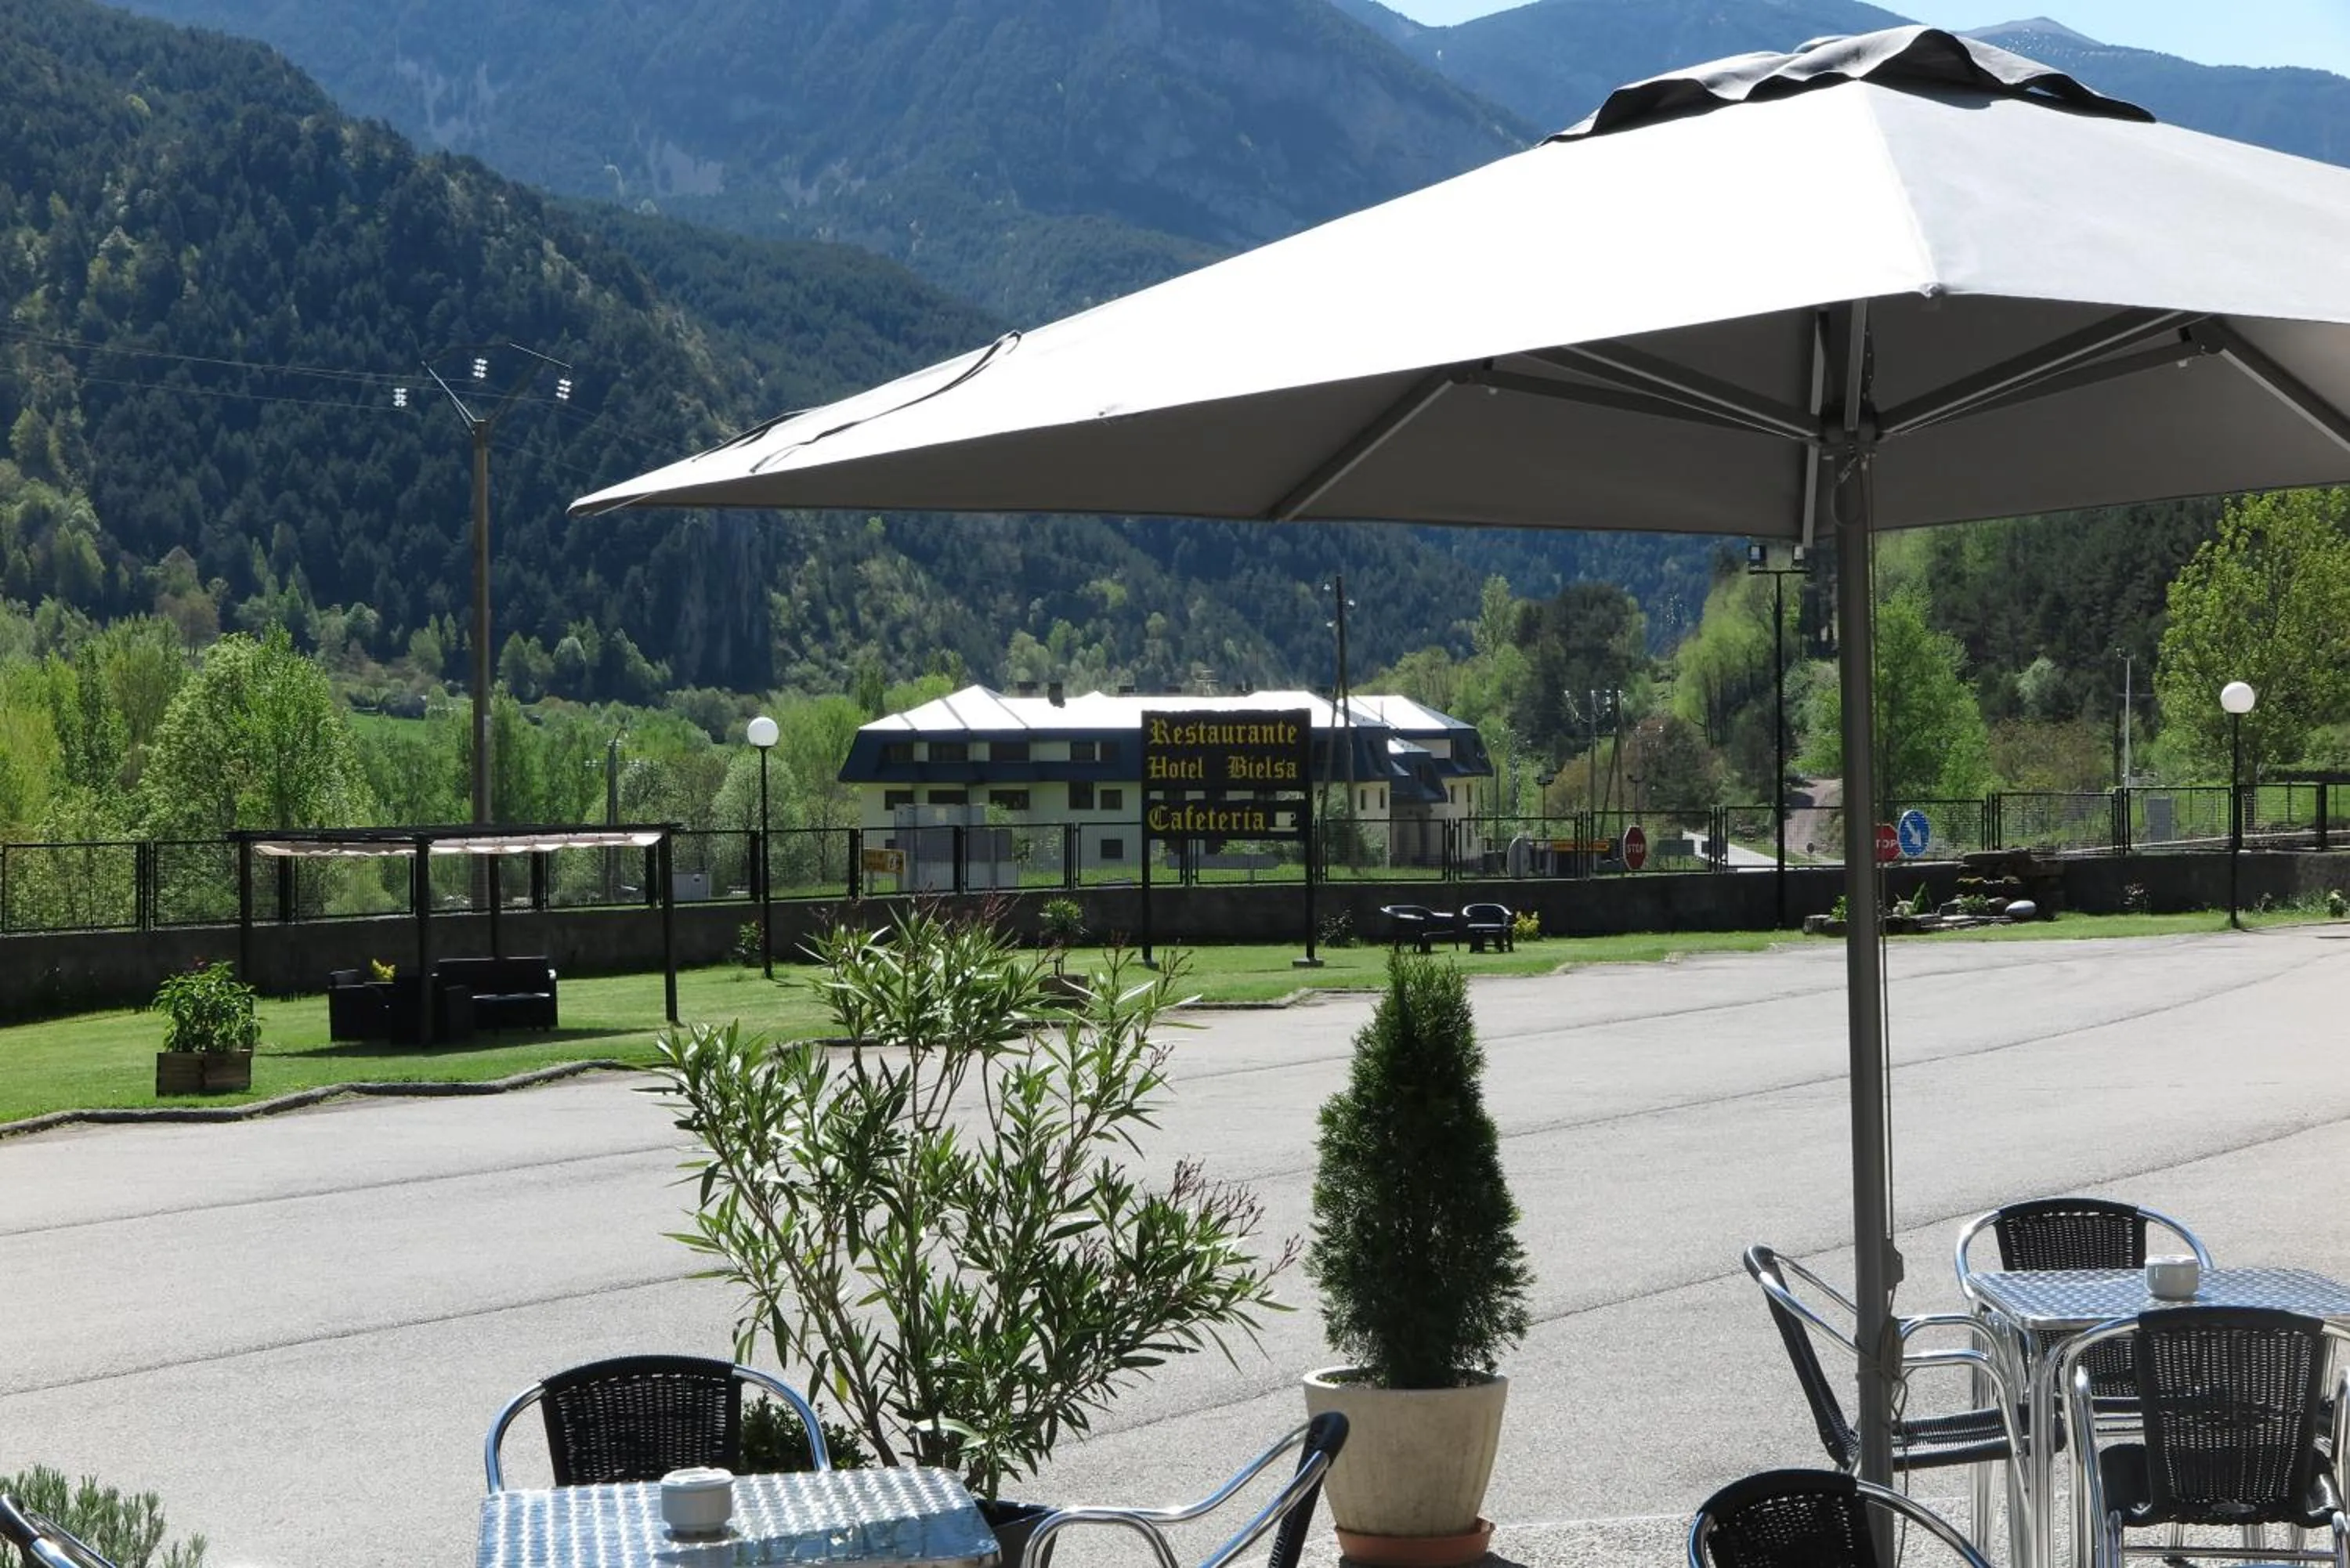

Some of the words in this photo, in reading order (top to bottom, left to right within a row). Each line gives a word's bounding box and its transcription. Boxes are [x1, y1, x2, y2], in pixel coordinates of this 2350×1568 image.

[1148, 717, 1298, 745] Restaurante
[1148, 756, 1203, 779] Hotel
[1227, 755, 1298, 779] Bielsa
[1626, 843, 1644, 853] STOP
[1875, 839, 1897, 850] TOP
